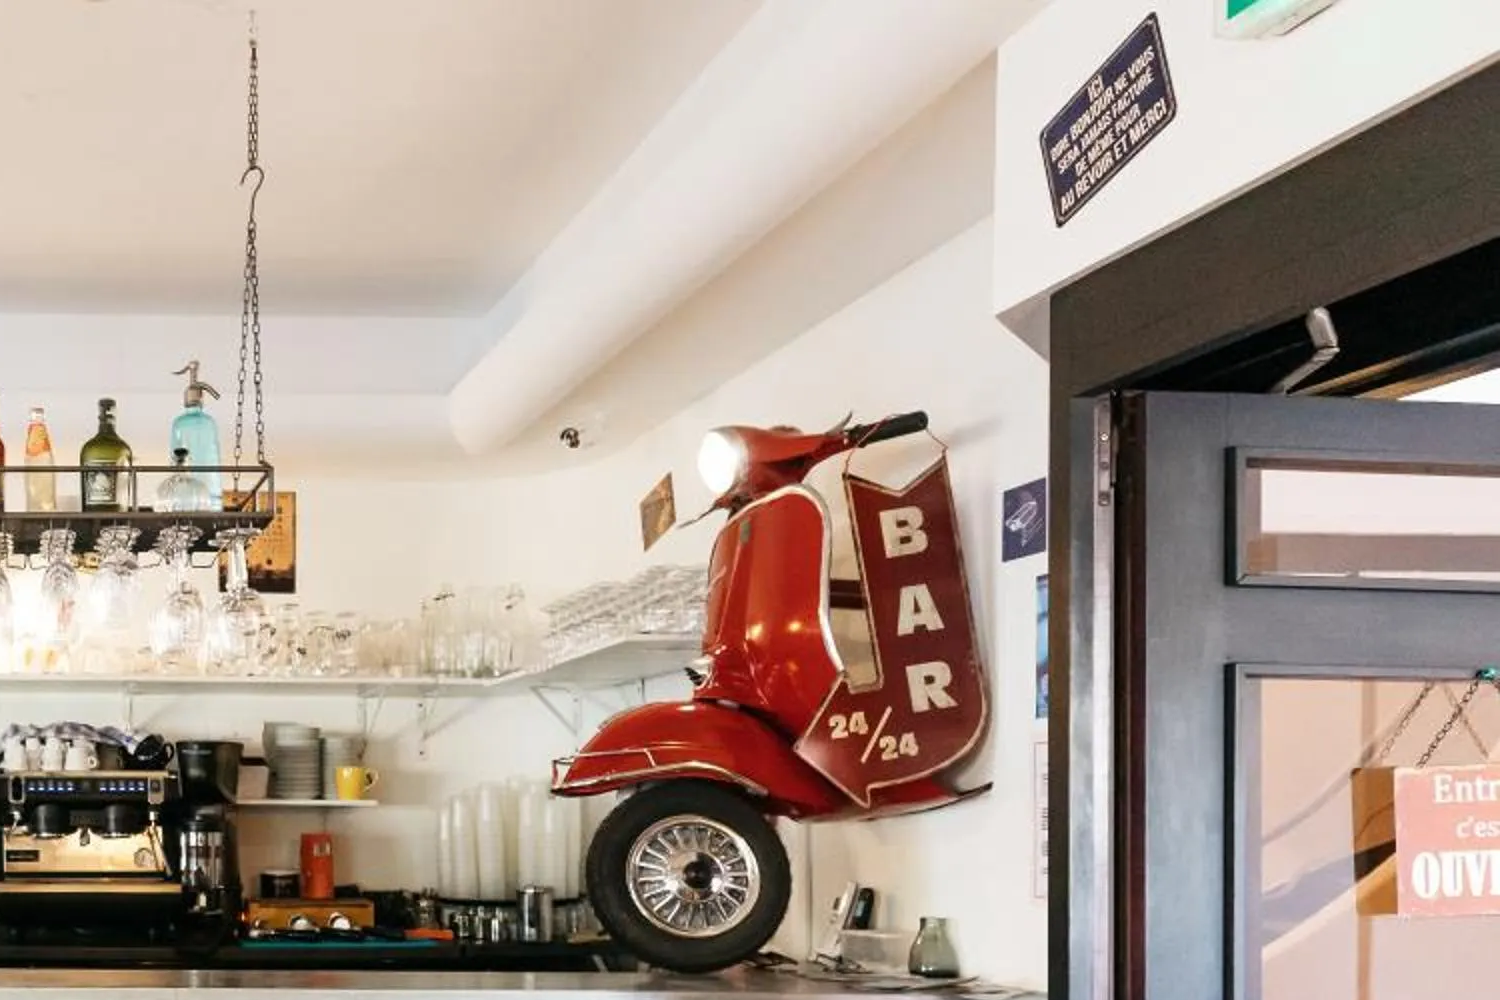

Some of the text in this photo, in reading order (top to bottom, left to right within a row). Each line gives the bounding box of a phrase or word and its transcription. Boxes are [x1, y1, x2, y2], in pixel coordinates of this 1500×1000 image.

[1069, 84, 1114, 142] BONJOUR
[1113, 70, 1128, 95] NE
[1127, 43, 1154, 81] VOUS
[1087, 73, 1104, 103] ICI
[1057, 141, 1080, 175] SERA
[1079, 108, 1112, 152] JAMAIS
[1059, 95, 1166, 214] AU REVOIR ET MERCI
[1074, 154, 1088, 177] DE
[1114, 101, 1140, 137] POUR
[878, 505, 959, 714] BAR
[828, 705, 919, 764] 24/24
